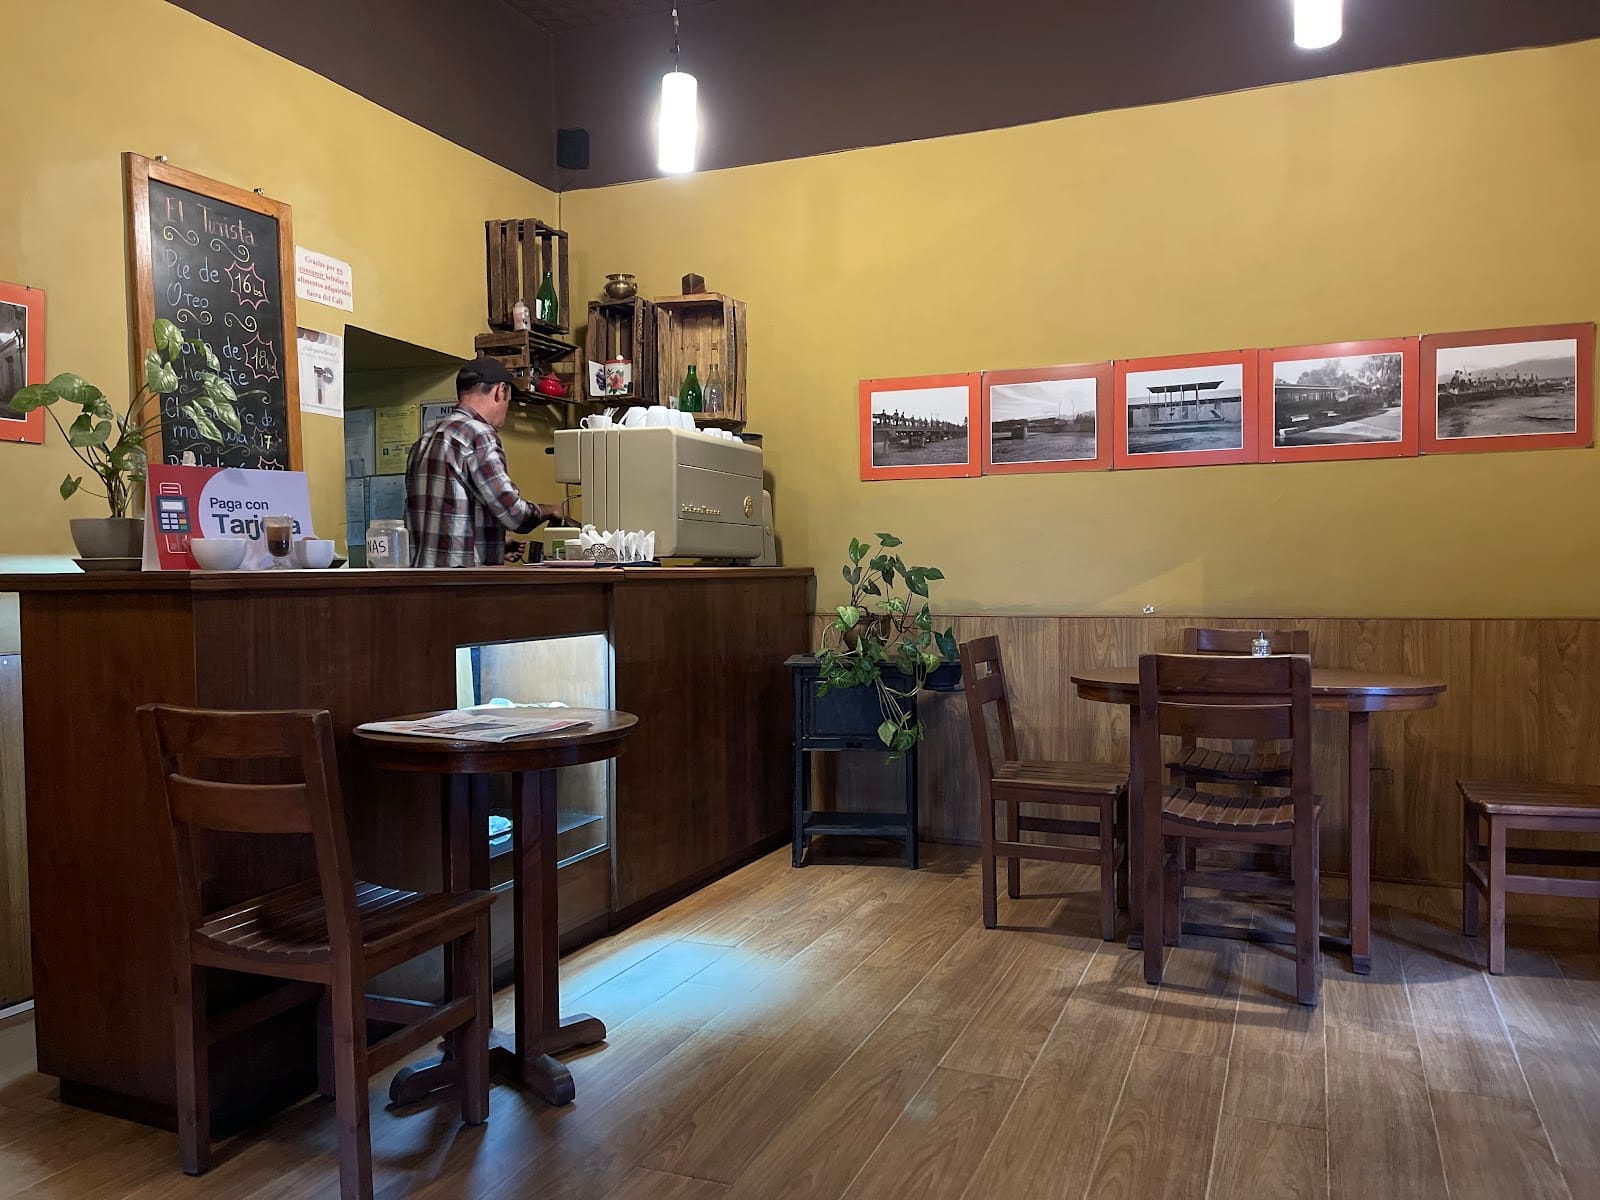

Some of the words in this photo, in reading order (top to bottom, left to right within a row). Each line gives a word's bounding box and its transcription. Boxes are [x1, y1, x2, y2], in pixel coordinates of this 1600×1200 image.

[167, 197, 184, 223] El
[196, 203, 255, 246] Turista
[166, 249, 191, 280] Pie
[199, 256, 221, 283] de
[305, 255, 326, 268] Gracias
[326, 264, 335, 272] por
[234, 272, 251, 294] 16
[298, 276, 324, 288] alimentos
[324, 284, 352, 297] adquiridos
[166, 281, 209, 309] Oreo
[323, 294, 331, 302] del
[222, 336, 242, 362] de
[251, 347, 266, 370] 18
[259, 433, 273, 450] 17
[209, 497, 243, 513] Paga
[245, 499, 270, 512] con
[211, 513, 302, 541] Tarja
